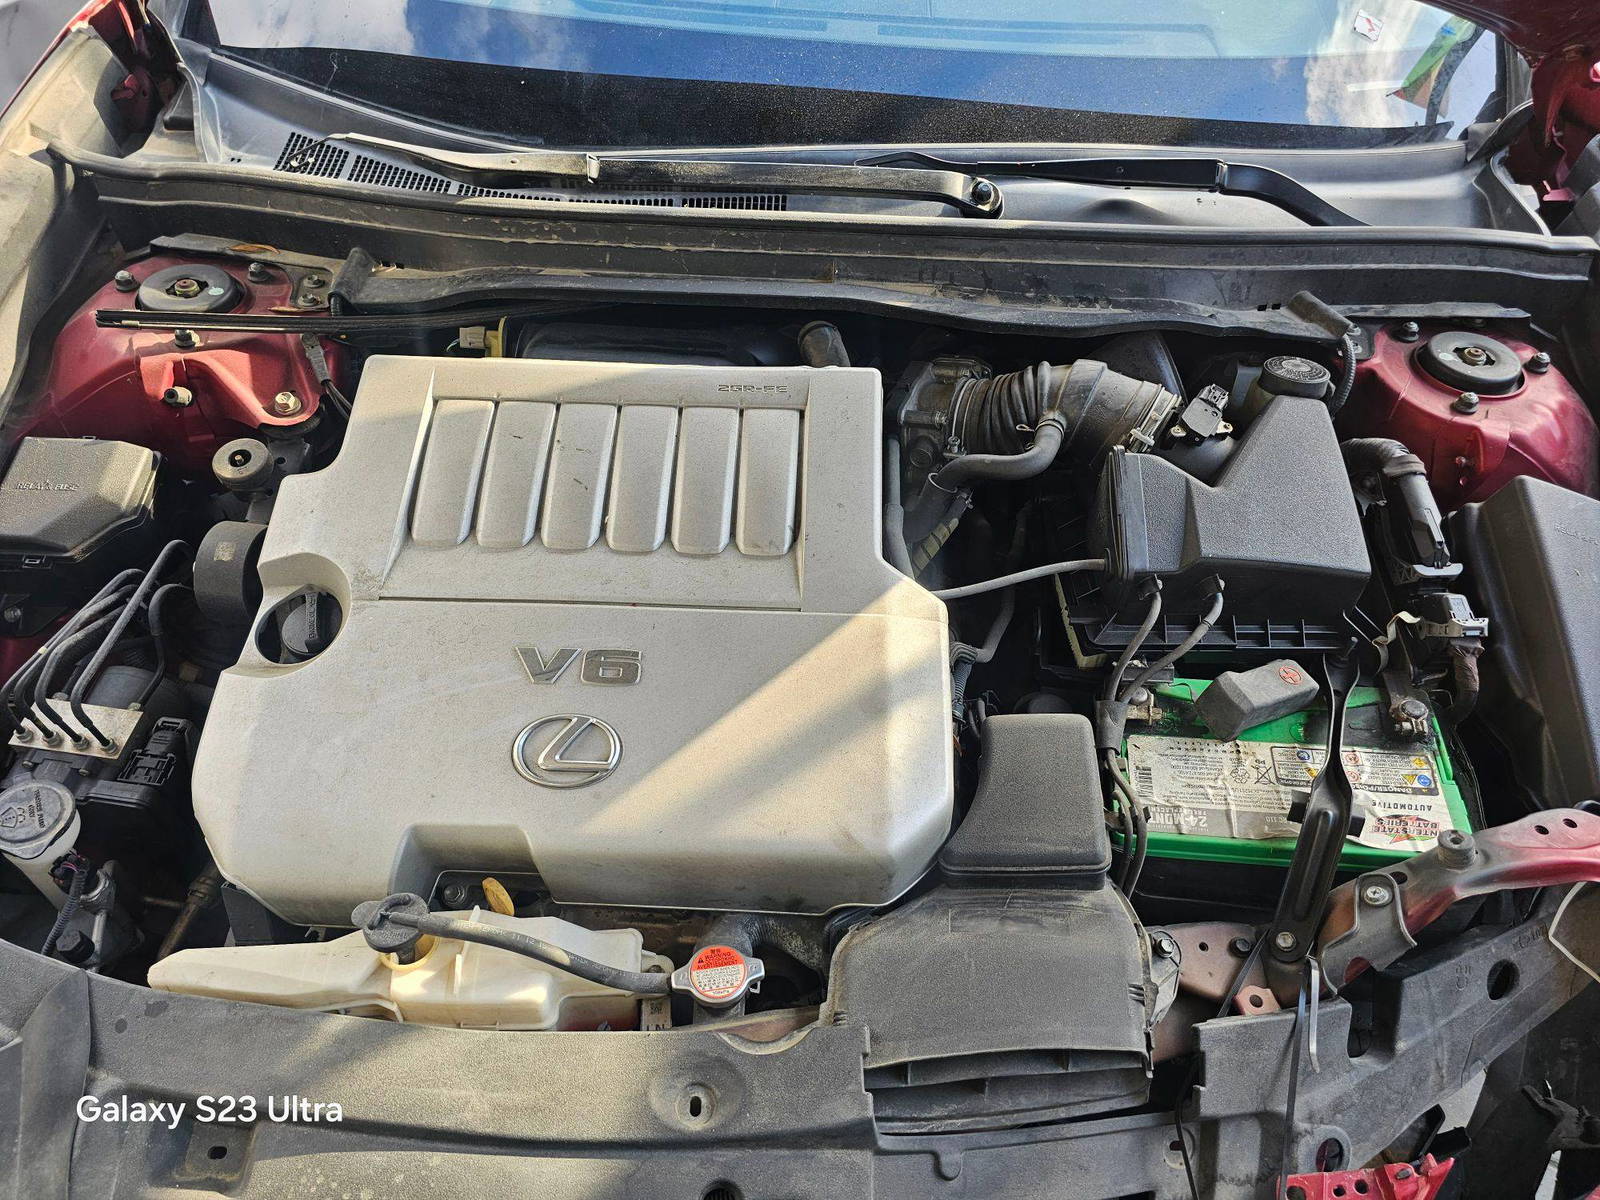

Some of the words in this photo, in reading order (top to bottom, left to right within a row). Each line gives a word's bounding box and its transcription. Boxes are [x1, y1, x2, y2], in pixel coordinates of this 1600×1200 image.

[717, 384, 788, 394] 2GR-FE
[513, 646, 643, 687] V6
[1371, 799, 1432, 811] AUTOMOTIVE
[1147, 811, 1208, 827] 24-MONT
[1373, 825, 1439, 837] NTERSTATE
